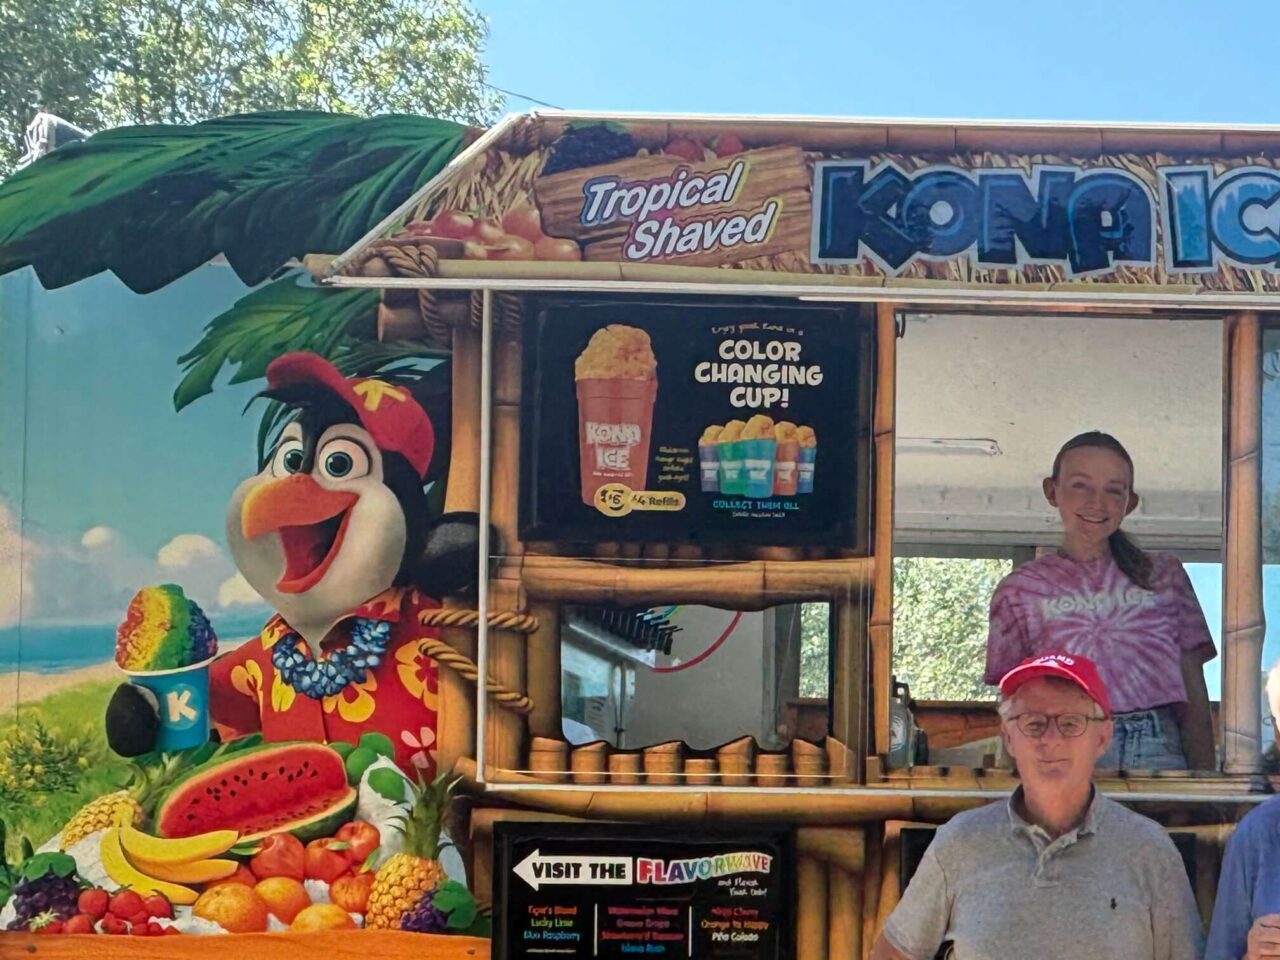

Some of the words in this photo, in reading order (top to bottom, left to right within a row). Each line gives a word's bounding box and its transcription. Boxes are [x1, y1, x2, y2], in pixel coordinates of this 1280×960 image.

[585, 160, 746, 222] Tropical
[625, 201, 778, 260] Shaved
[814, 161, 1155, 276] KONA
[718, 339, 802, 362] COLOR
[694, 361, 824, 386] CHANGING
[729, 386, 790, 408] CUP!
[712, 500, 752, 509] COLLECT
[166, 690, 198, 723] K
[531, 862, 582, 879] VISIT
[588, 863, 626, 879] THE
[637, 852, 773, 885] FLAVORWAVE
